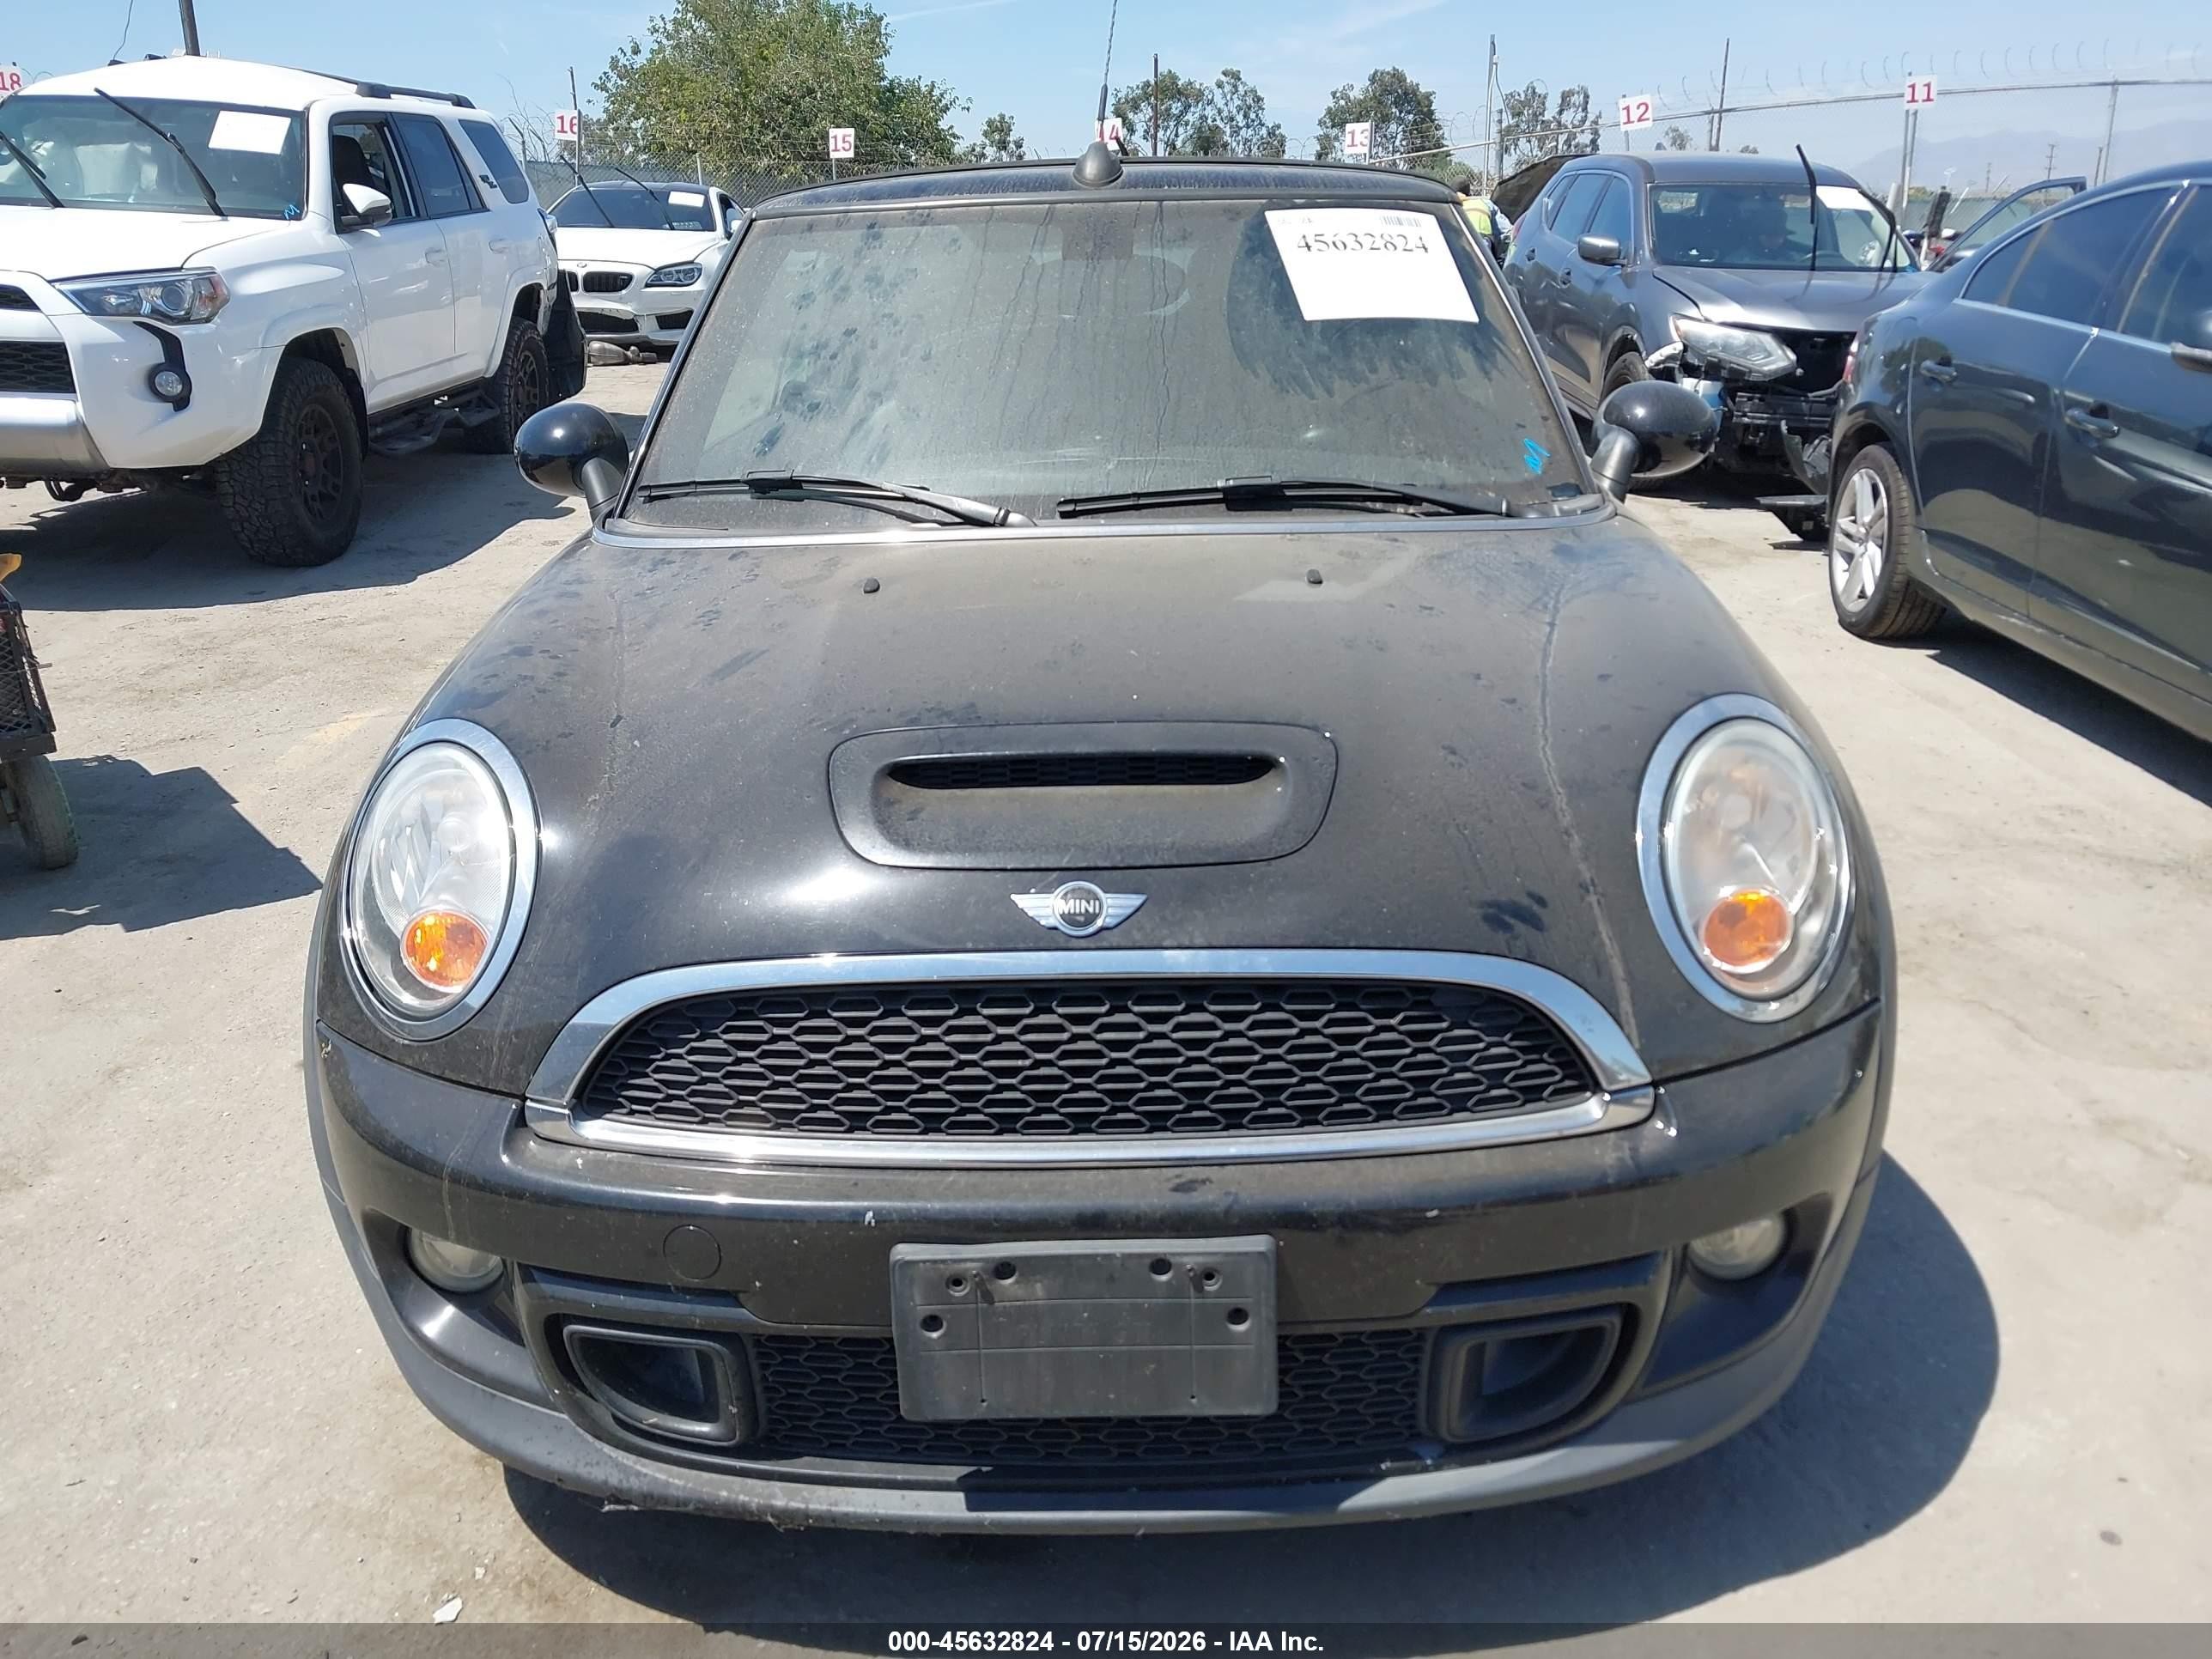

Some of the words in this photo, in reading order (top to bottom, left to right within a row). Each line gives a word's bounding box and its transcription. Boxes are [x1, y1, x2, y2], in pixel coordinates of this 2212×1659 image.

[1906, 82, 1935, 103] 11
[1622, 101, 1650, 125] 12
[830, 133, 853, 153] 15
[1297, 233, 1429, 253] 45632824
[1057, 898, 1100, 915] MINI
